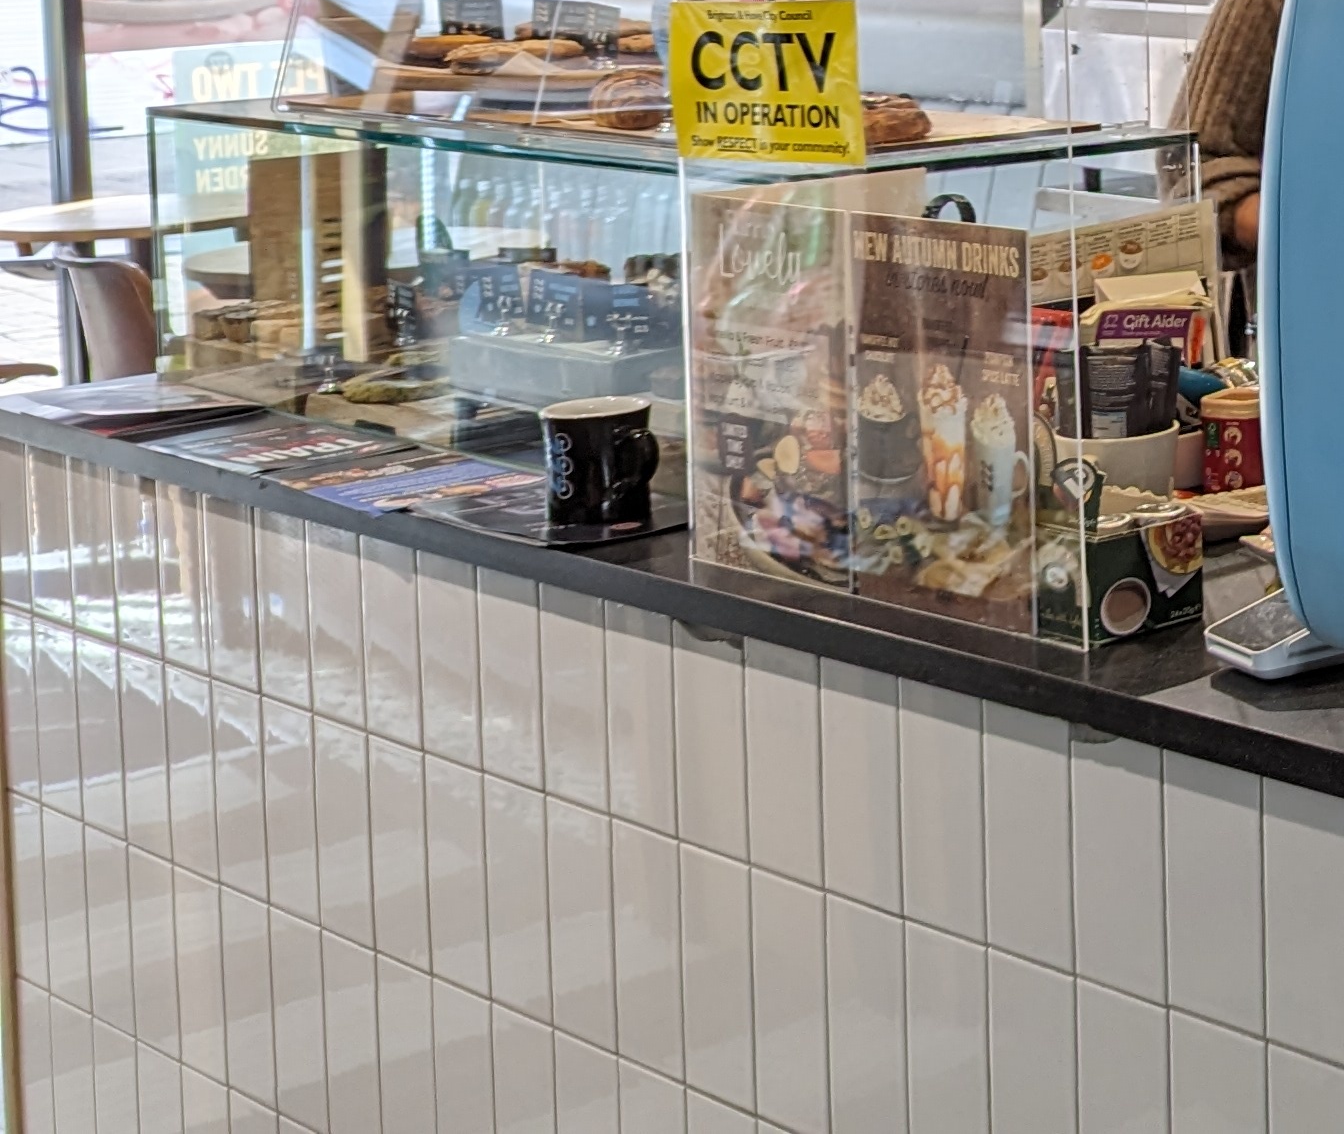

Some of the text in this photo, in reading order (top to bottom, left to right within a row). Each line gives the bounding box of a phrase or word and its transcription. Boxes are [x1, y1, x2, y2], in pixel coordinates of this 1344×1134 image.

[691, 30, 837, 94] CCTV
[696, 101, 840, 129] IN OPERATION
[853, 230, 1020, 279] NEW AUTUMN DRINKS
[1122, 313, 1189, 332] Gift Aider
